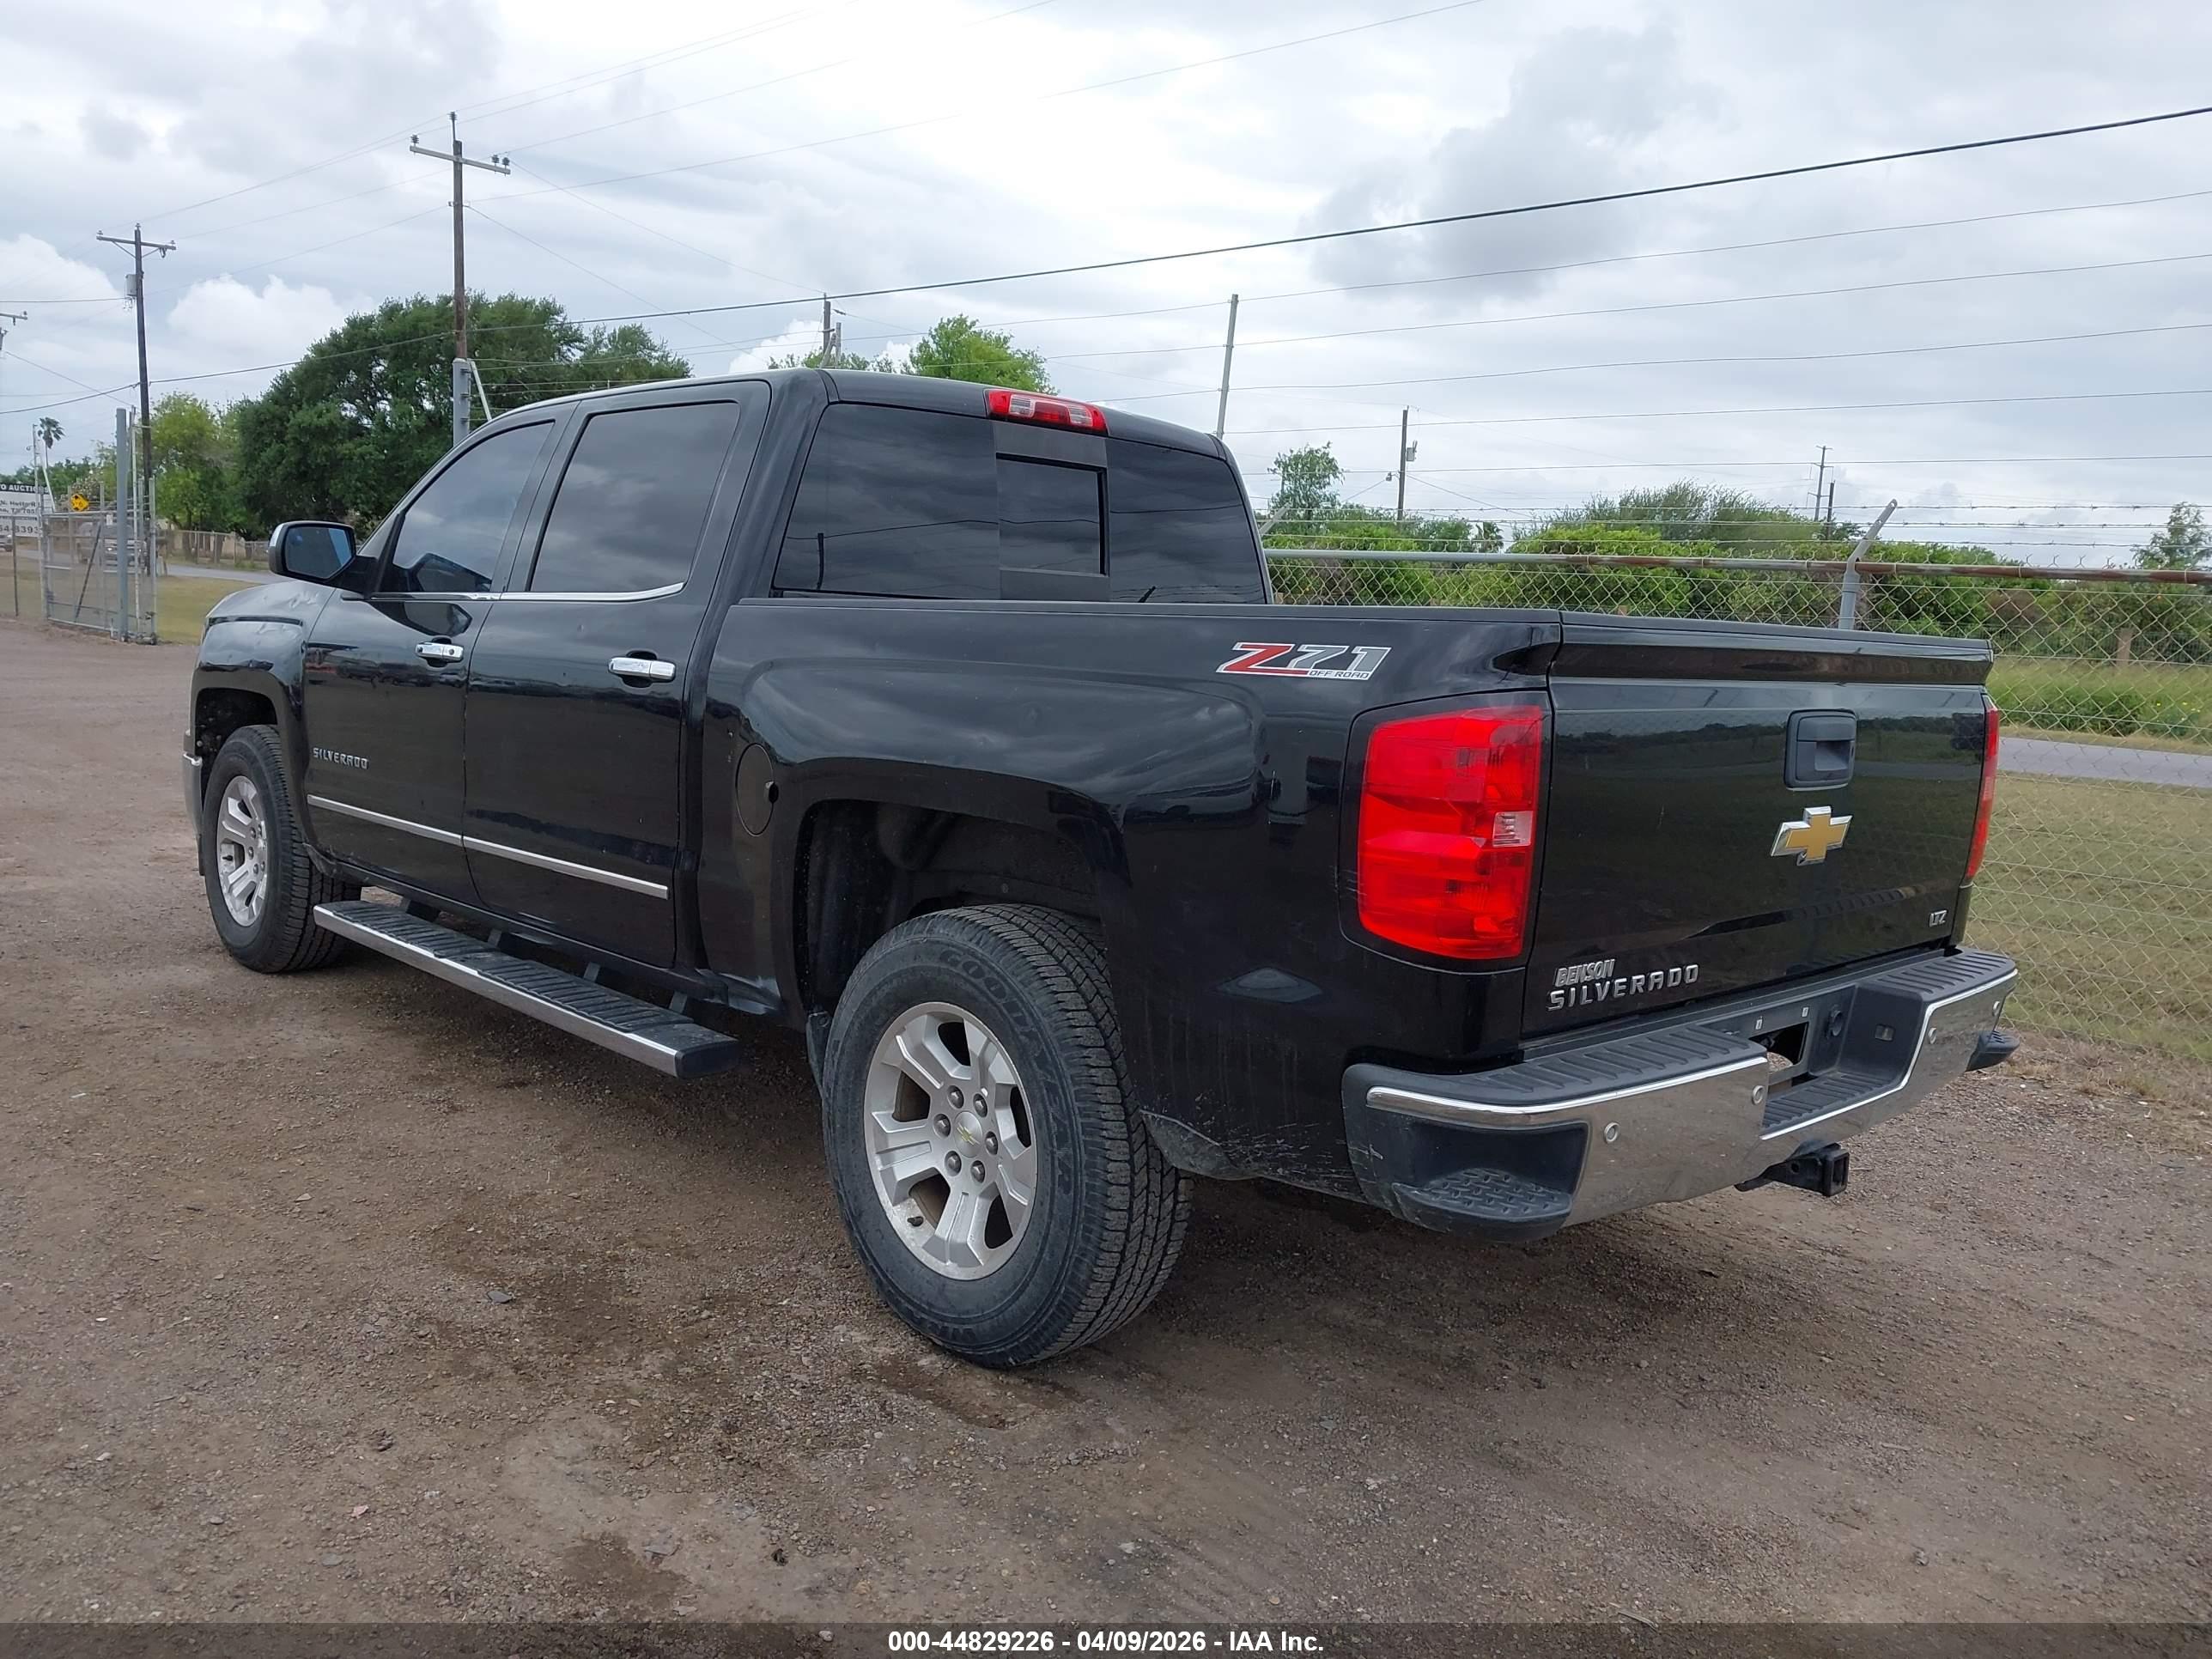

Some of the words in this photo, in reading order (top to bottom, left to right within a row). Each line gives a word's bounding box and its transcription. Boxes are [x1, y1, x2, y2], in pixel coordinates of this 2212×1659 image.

[1215, 641, 1392, 678] Z71
[1309, 670, 1333, 678] OFF
[1334, 671, 1370, 680] ROAD
[312, 746, 369, 770] SILVERADO
[1929, 909, 1948, 927] LTZ
[1554, 958, 1615, 987] BENSON
[1547, 963, 1699, 1012] SILVERADO
